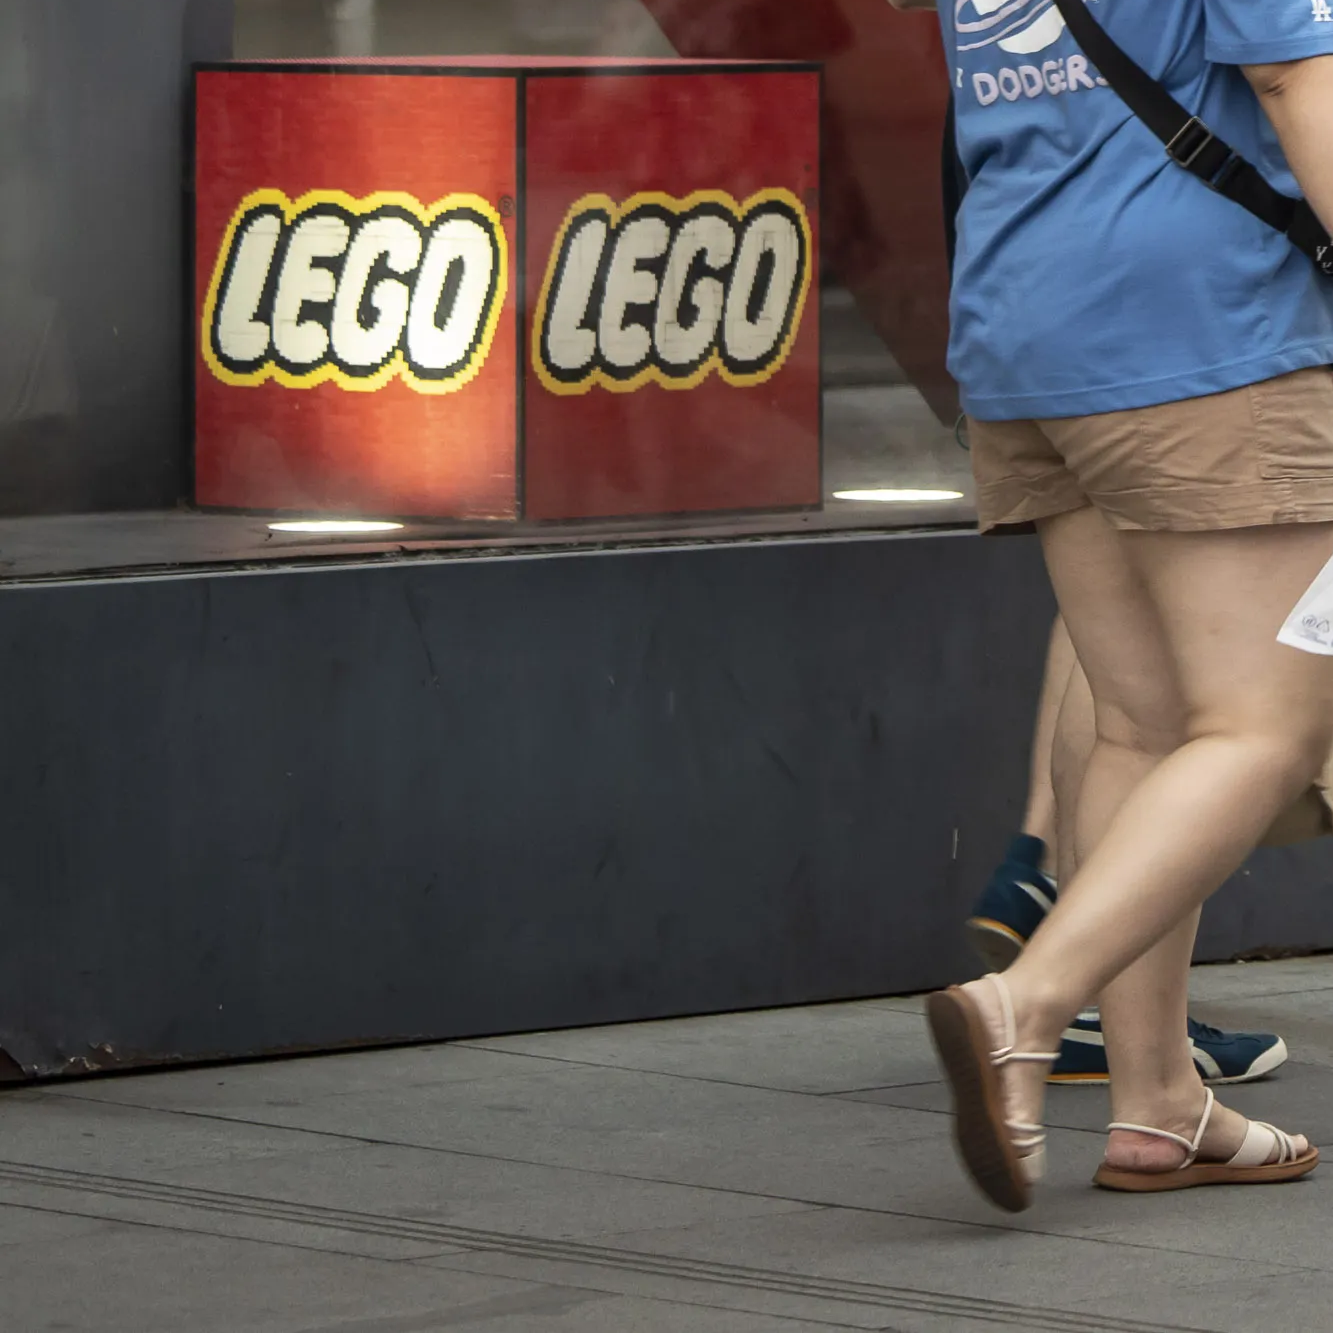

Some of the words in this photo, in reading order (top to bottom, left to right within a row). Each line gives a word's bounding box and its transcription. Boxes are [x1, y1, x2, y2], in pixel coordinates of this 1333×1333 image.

[972, 54, 1109, 106] DODGER
[208, 201, 502, 382] LEGO
[537, 201, 806, 382] LEGO
